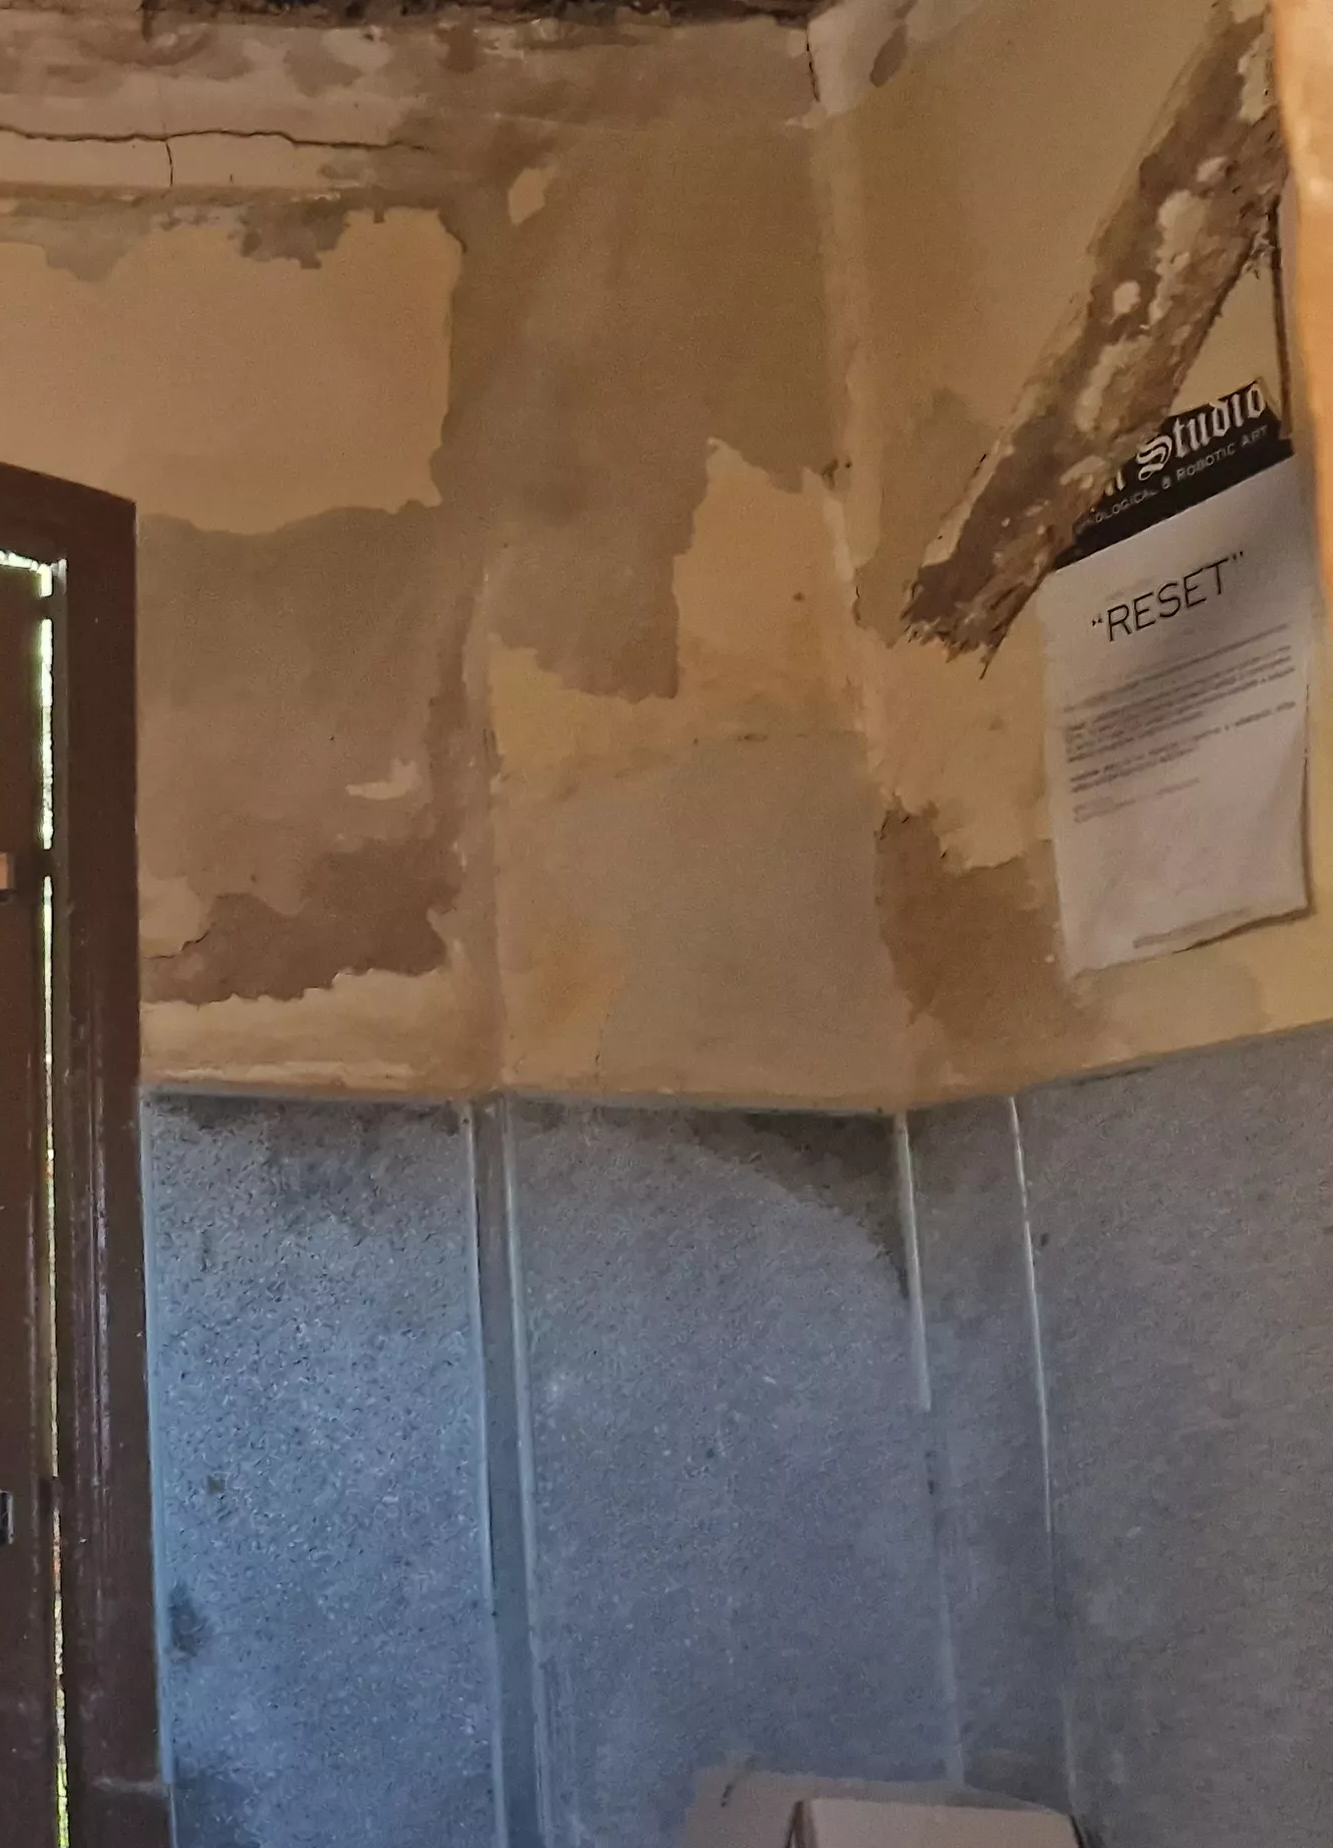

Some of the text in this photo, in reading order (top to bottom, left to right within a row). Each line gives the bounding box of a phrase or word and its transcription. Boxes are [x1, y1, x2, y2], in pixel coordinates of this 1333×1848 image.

[1090, 486, 1159, 524] OLOGICAL
[1175, 441, 1237, 483] ROBOTIC
[1240, 424, 1269, 449] ART
[1135, 382, 1267, 482] Studio
